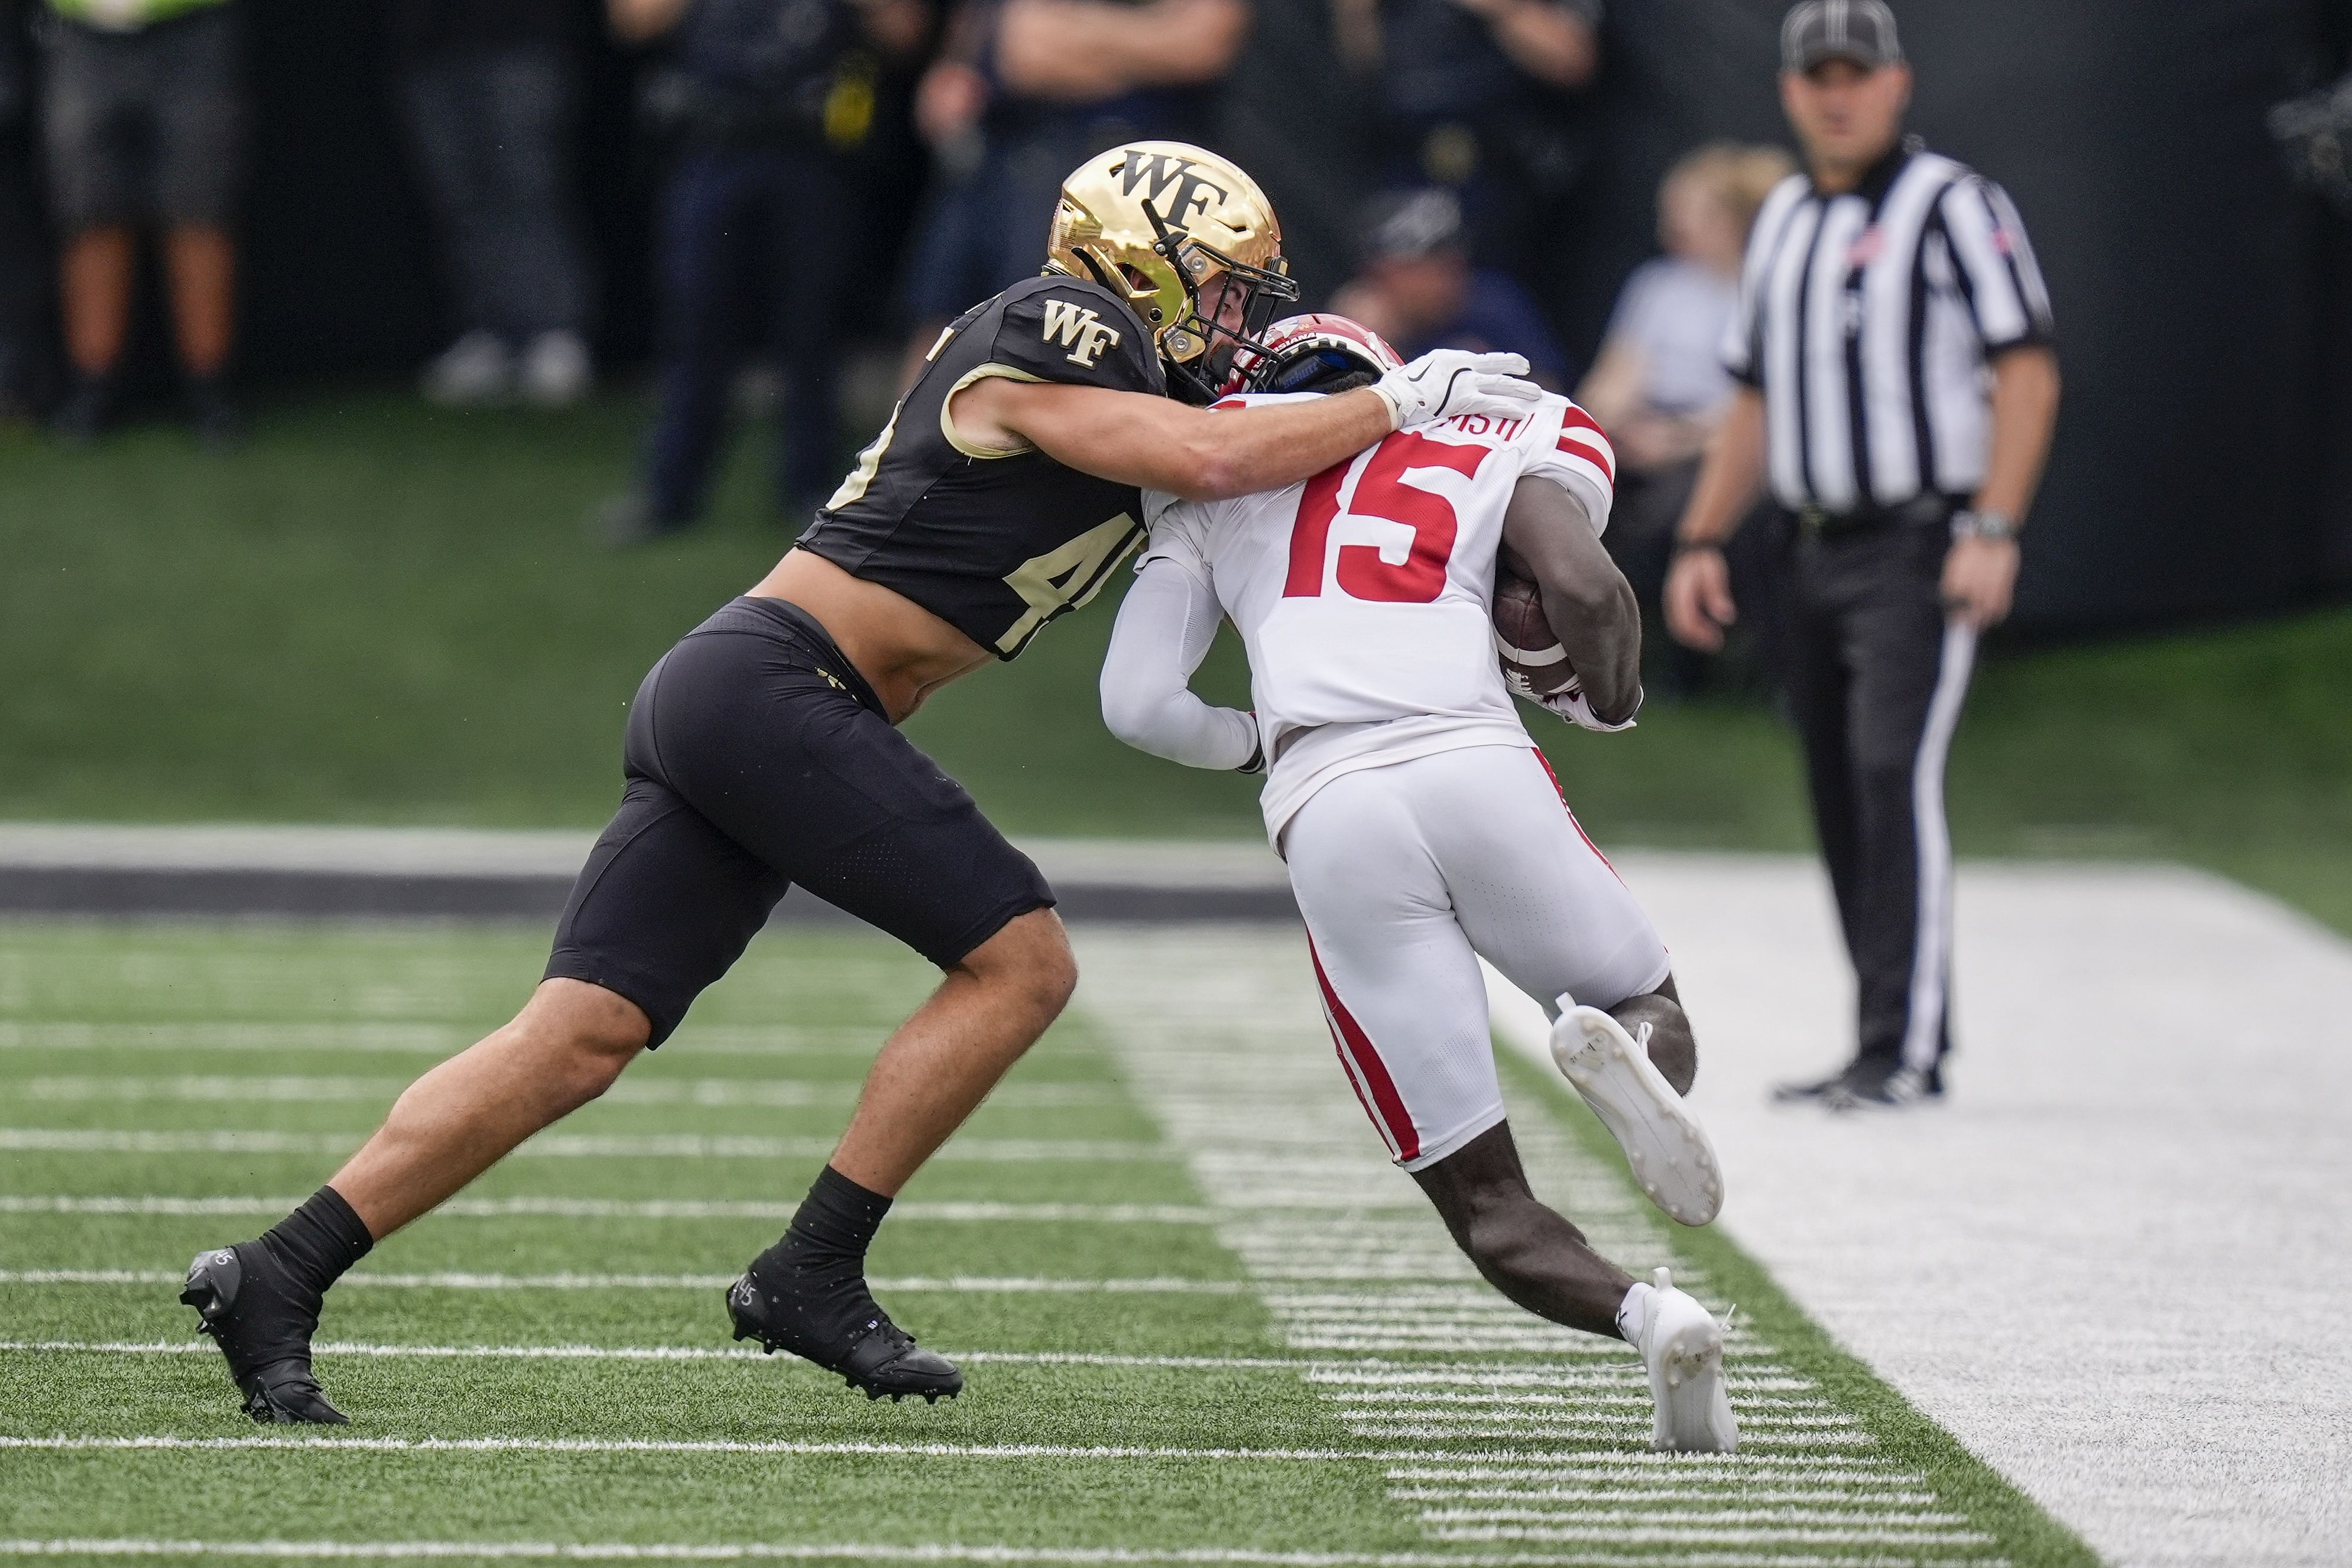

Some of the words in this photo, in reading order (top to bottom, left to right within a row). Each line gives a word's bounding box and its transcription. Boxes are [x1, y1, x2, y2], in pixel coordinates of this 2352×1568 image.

[1123, 150, 1228, 231] WF
[1043, 299, 1121, 369] WF
[1282, 430, 1493, 603] 15
[994, 512, 1148, 660] 4
[739, 1280, 757, 1306] 45
